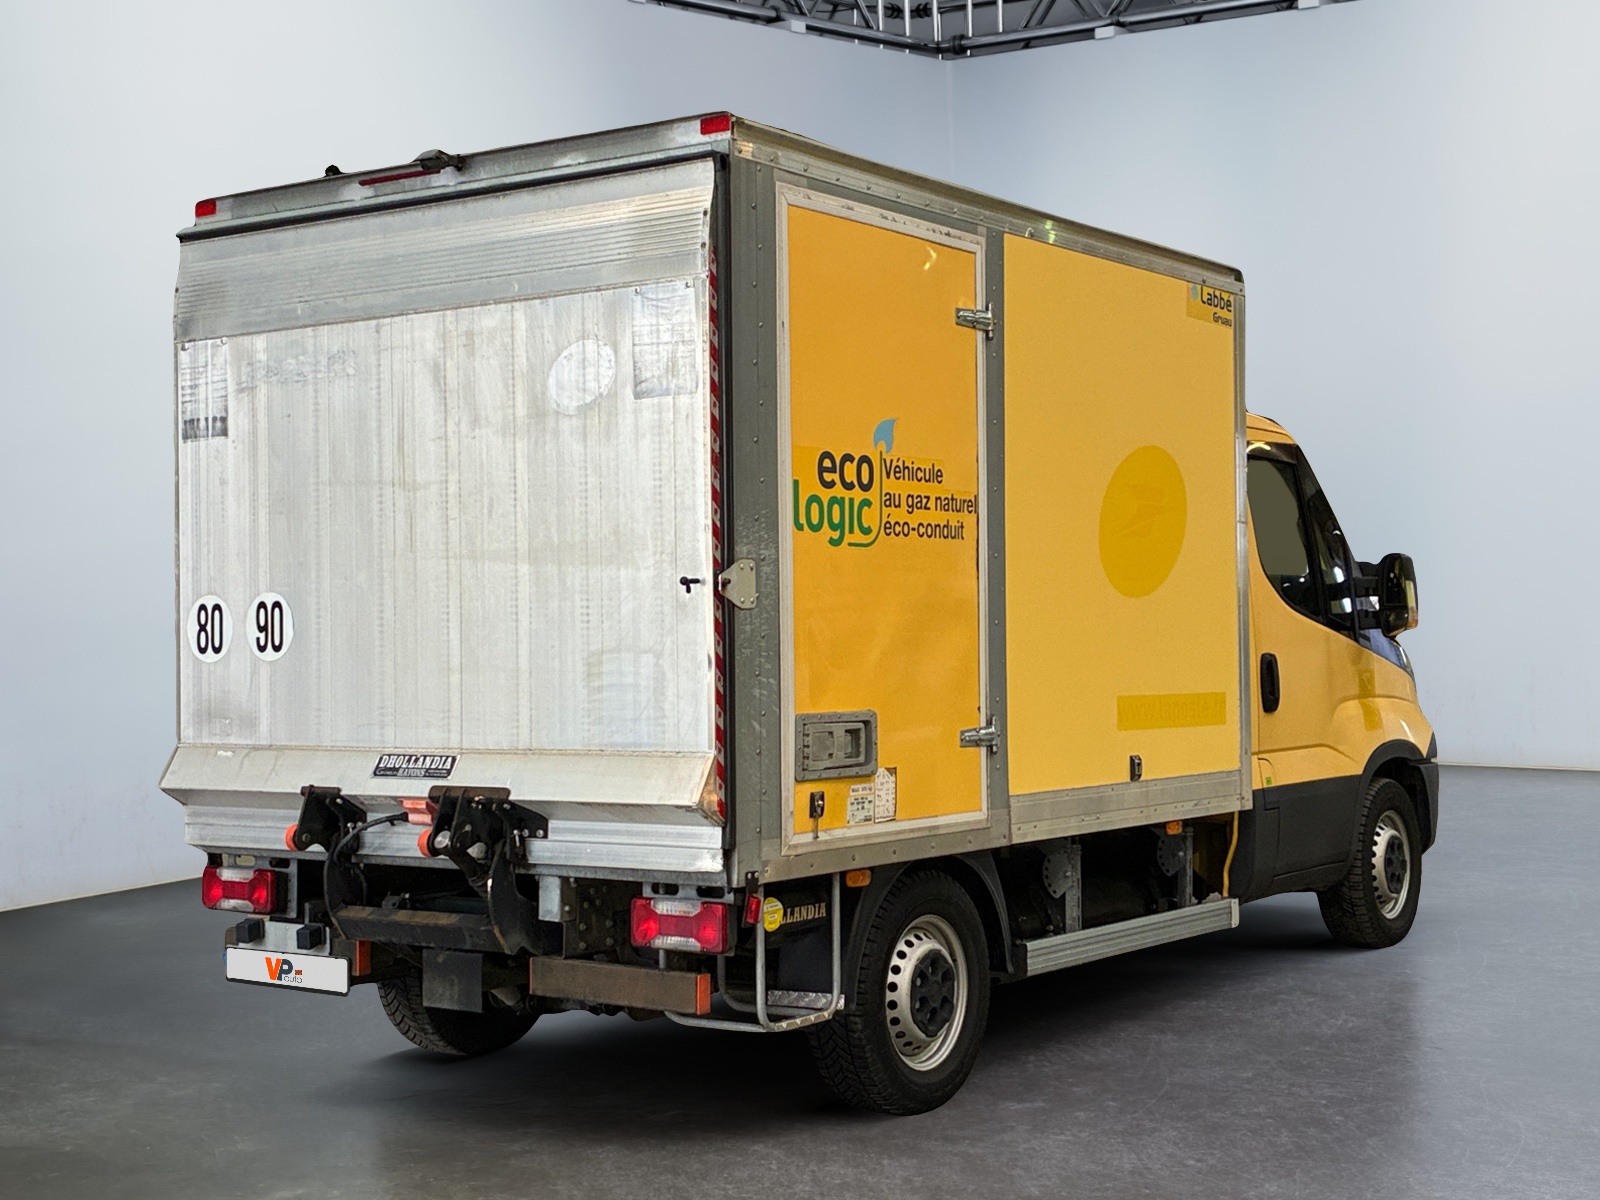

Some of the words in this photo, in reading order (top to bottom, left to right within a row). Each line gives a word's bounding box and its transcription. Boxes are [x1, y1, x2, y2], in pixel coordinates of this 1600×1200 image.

[1200, 286, 1232, 313] Labbé
[817, 450, 875, 493] eco
[883, 457, 944, 484] Véhicule
[793, 479, 874, 548] logic
[883, 491, 901, 509] au
[905, 492, 931, 515] gaz
[934, 494, 977, 515] naturel
[883, 513, 965, 540] éco-conduit
[196, 603, 223, 655] 80
[256, 600, 284, 654] 90
[379, 755, 452, 769] DHOLLANDIA
